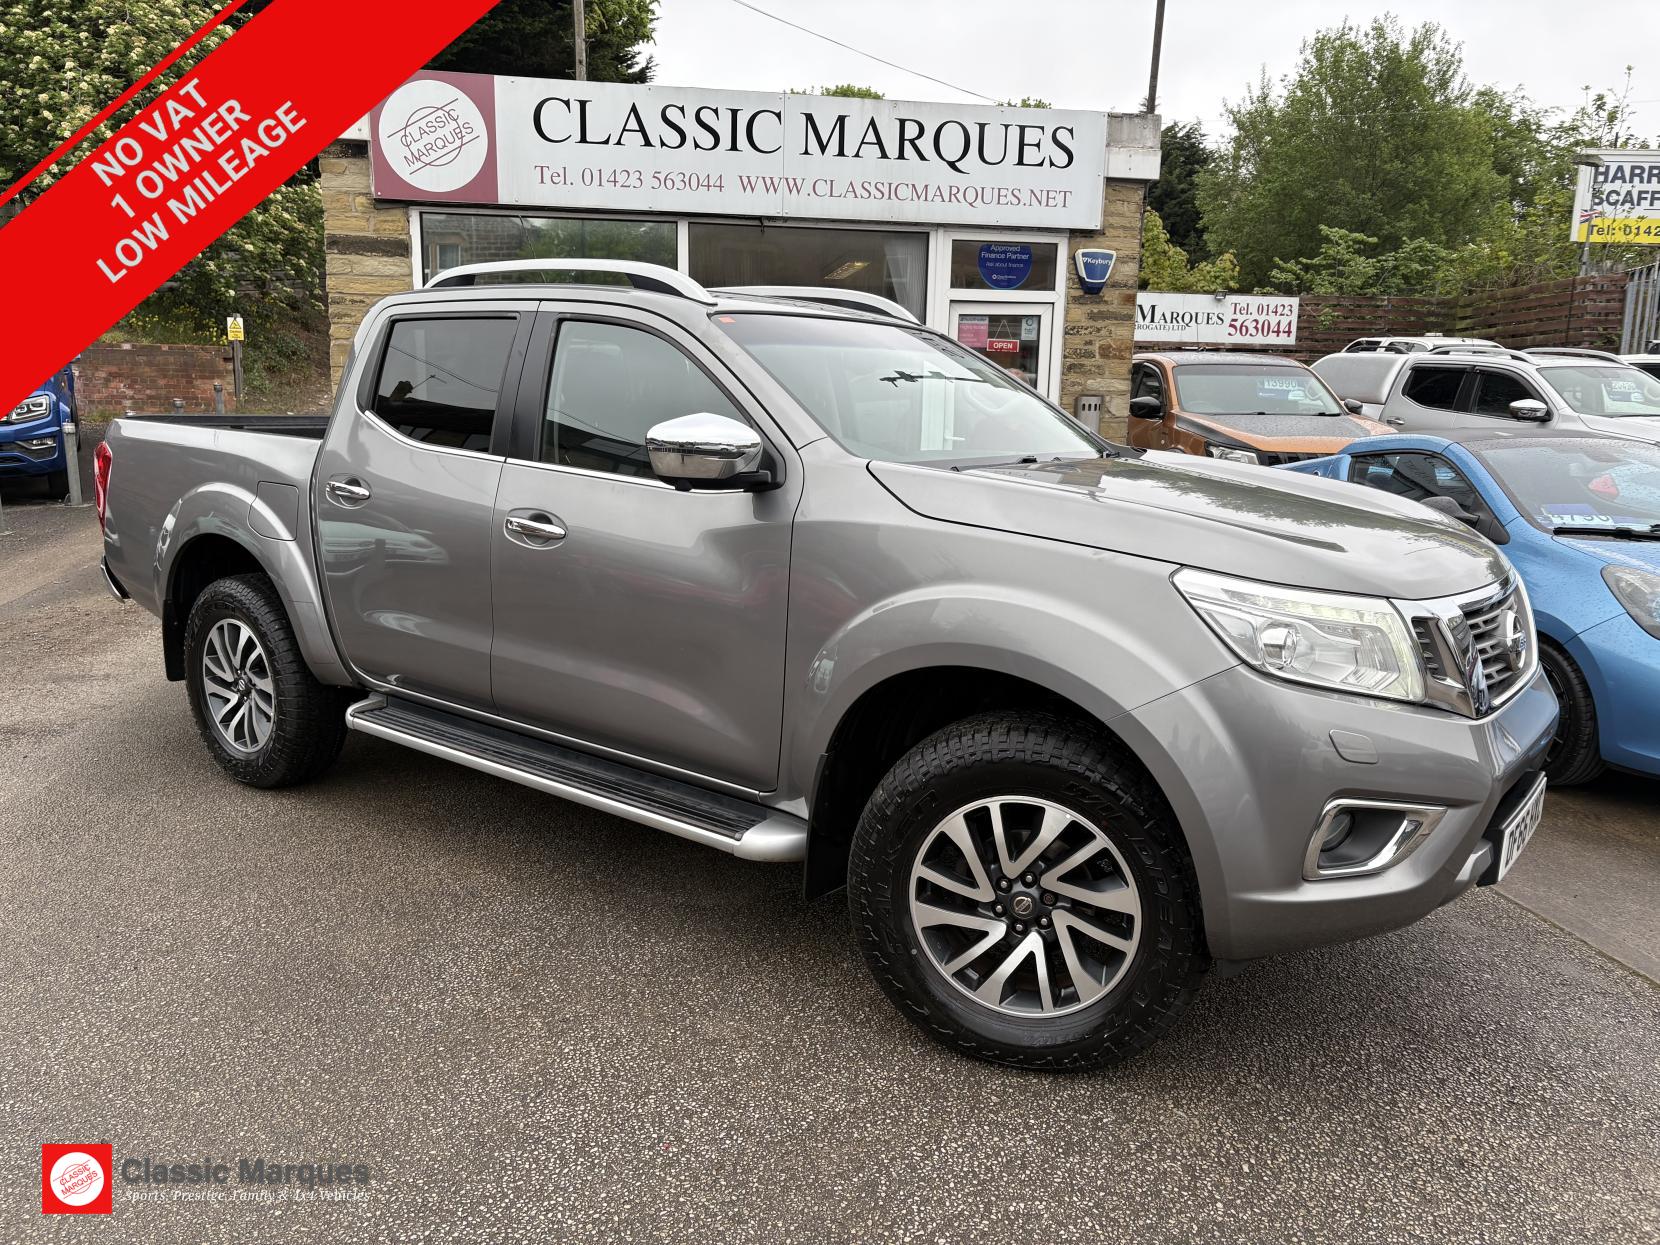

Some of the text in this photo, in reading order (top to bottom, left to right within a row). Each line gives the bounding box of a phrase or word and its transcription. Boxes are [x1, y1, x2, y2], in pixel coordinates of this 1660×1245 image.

[400, 108, 460, 148] CLASSIC
[532, 96, 1075, 175] CLASSIC MARQUES
[403, 121, 474, 168] MARQUES
[1593, 164, 1660, 184] HARR
[534, 165, 1073, 209] Tel. 01423 563044 WWW.CLASSICMARQUES.NET
[981, 251, 1030, 260] Finance Partner
[990, 244, 1021, 252] Approved
[1136, 302, 1294, 328] MARQUES Tel. 01423
[1135, 323, 1187, 332] ROGATE) LTD
[1227, 318, 1294, 338] 563044
[993, 342, 1013, 350] OPEN
